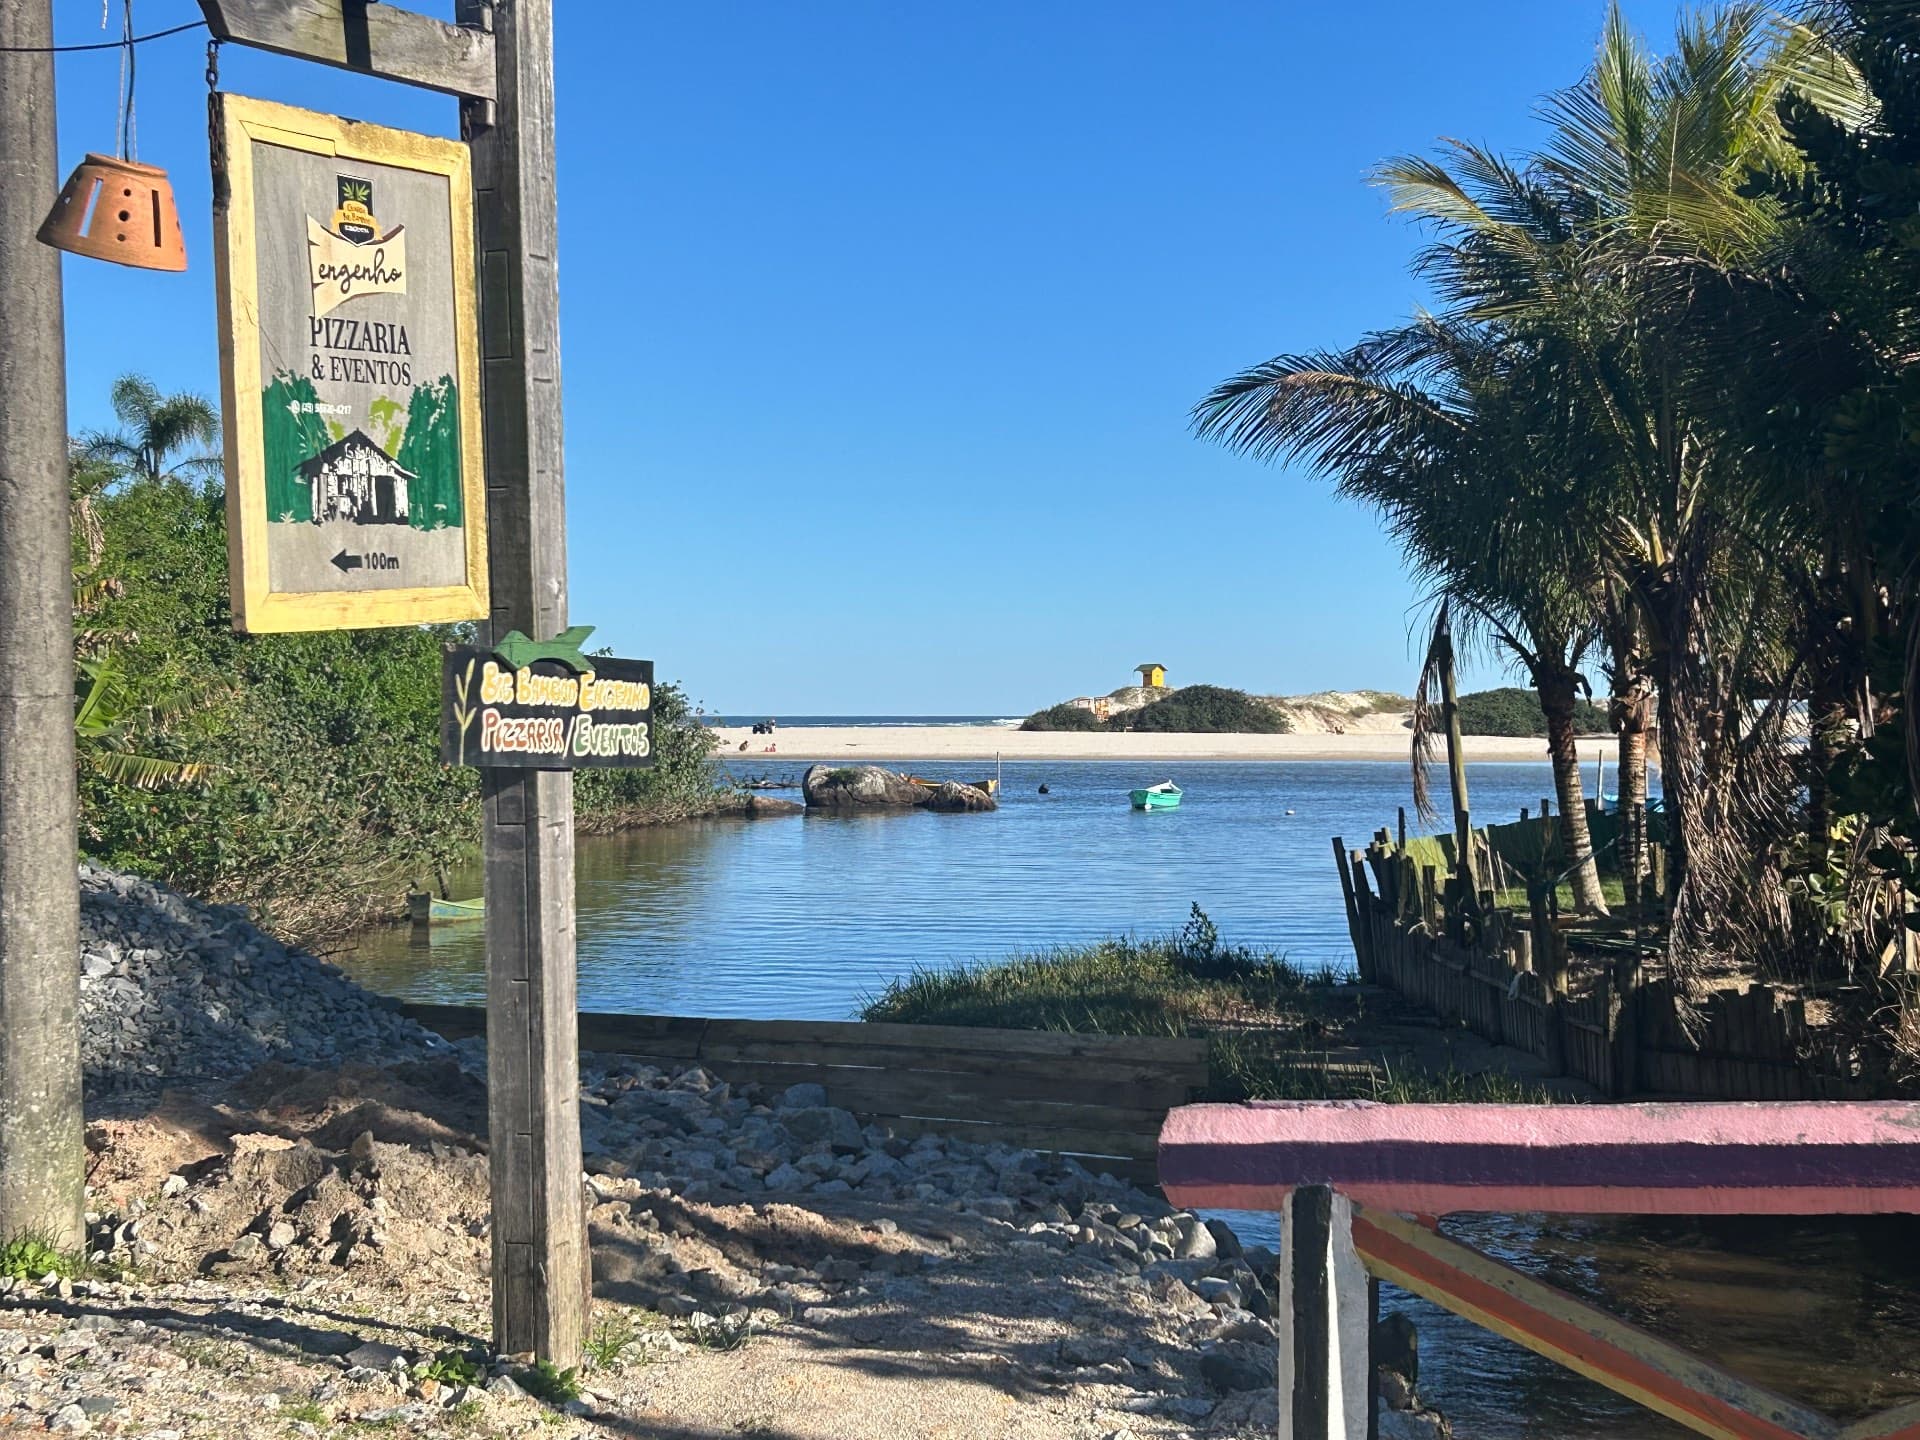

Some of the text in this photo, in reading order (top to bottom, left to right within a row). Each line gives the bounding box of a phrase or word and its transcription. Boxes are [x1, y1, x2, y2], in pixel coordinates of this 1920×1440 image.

[319, 248, 402, 294] engenho
[308, 315, 412, 355] PIZZARIA
[311, 353, 411, 387] & EVENTOS
[364, 552, 399, 569] 100m
